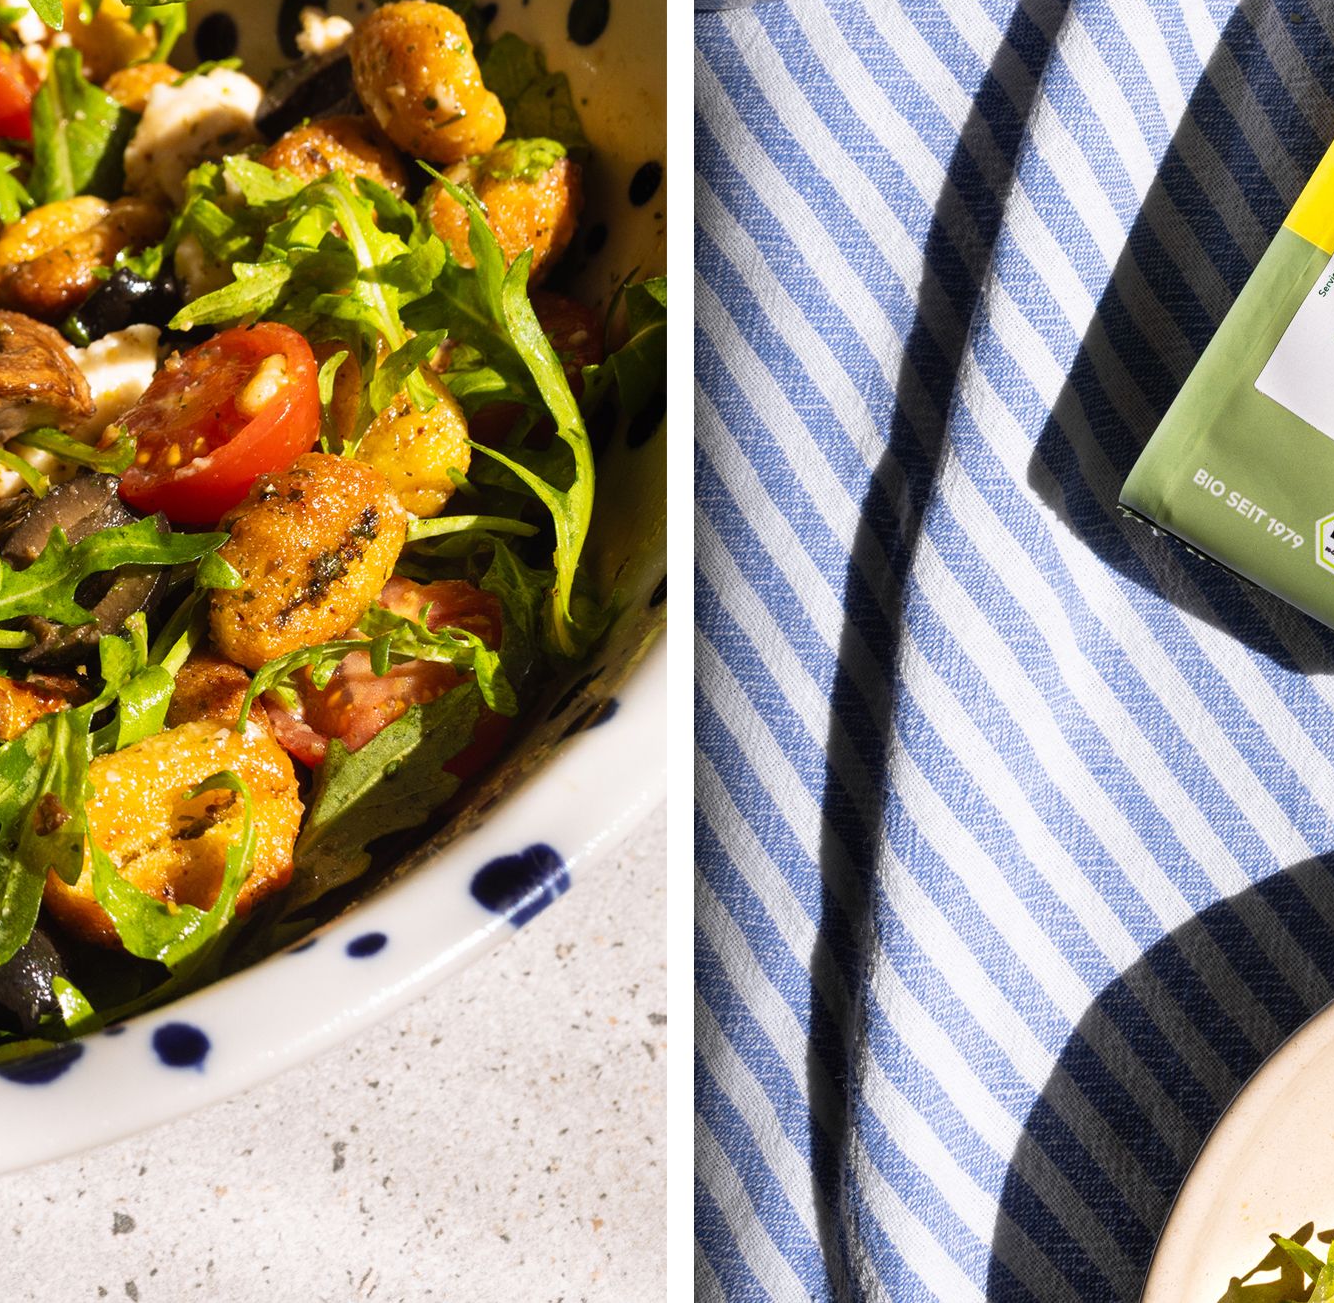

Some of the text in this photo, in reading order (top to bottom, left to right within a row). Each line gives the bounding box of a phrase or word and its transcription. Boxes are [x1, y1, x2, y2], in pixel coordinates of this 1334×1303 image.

[1193, 468, 1304, 549] BIO SEIT 1979
